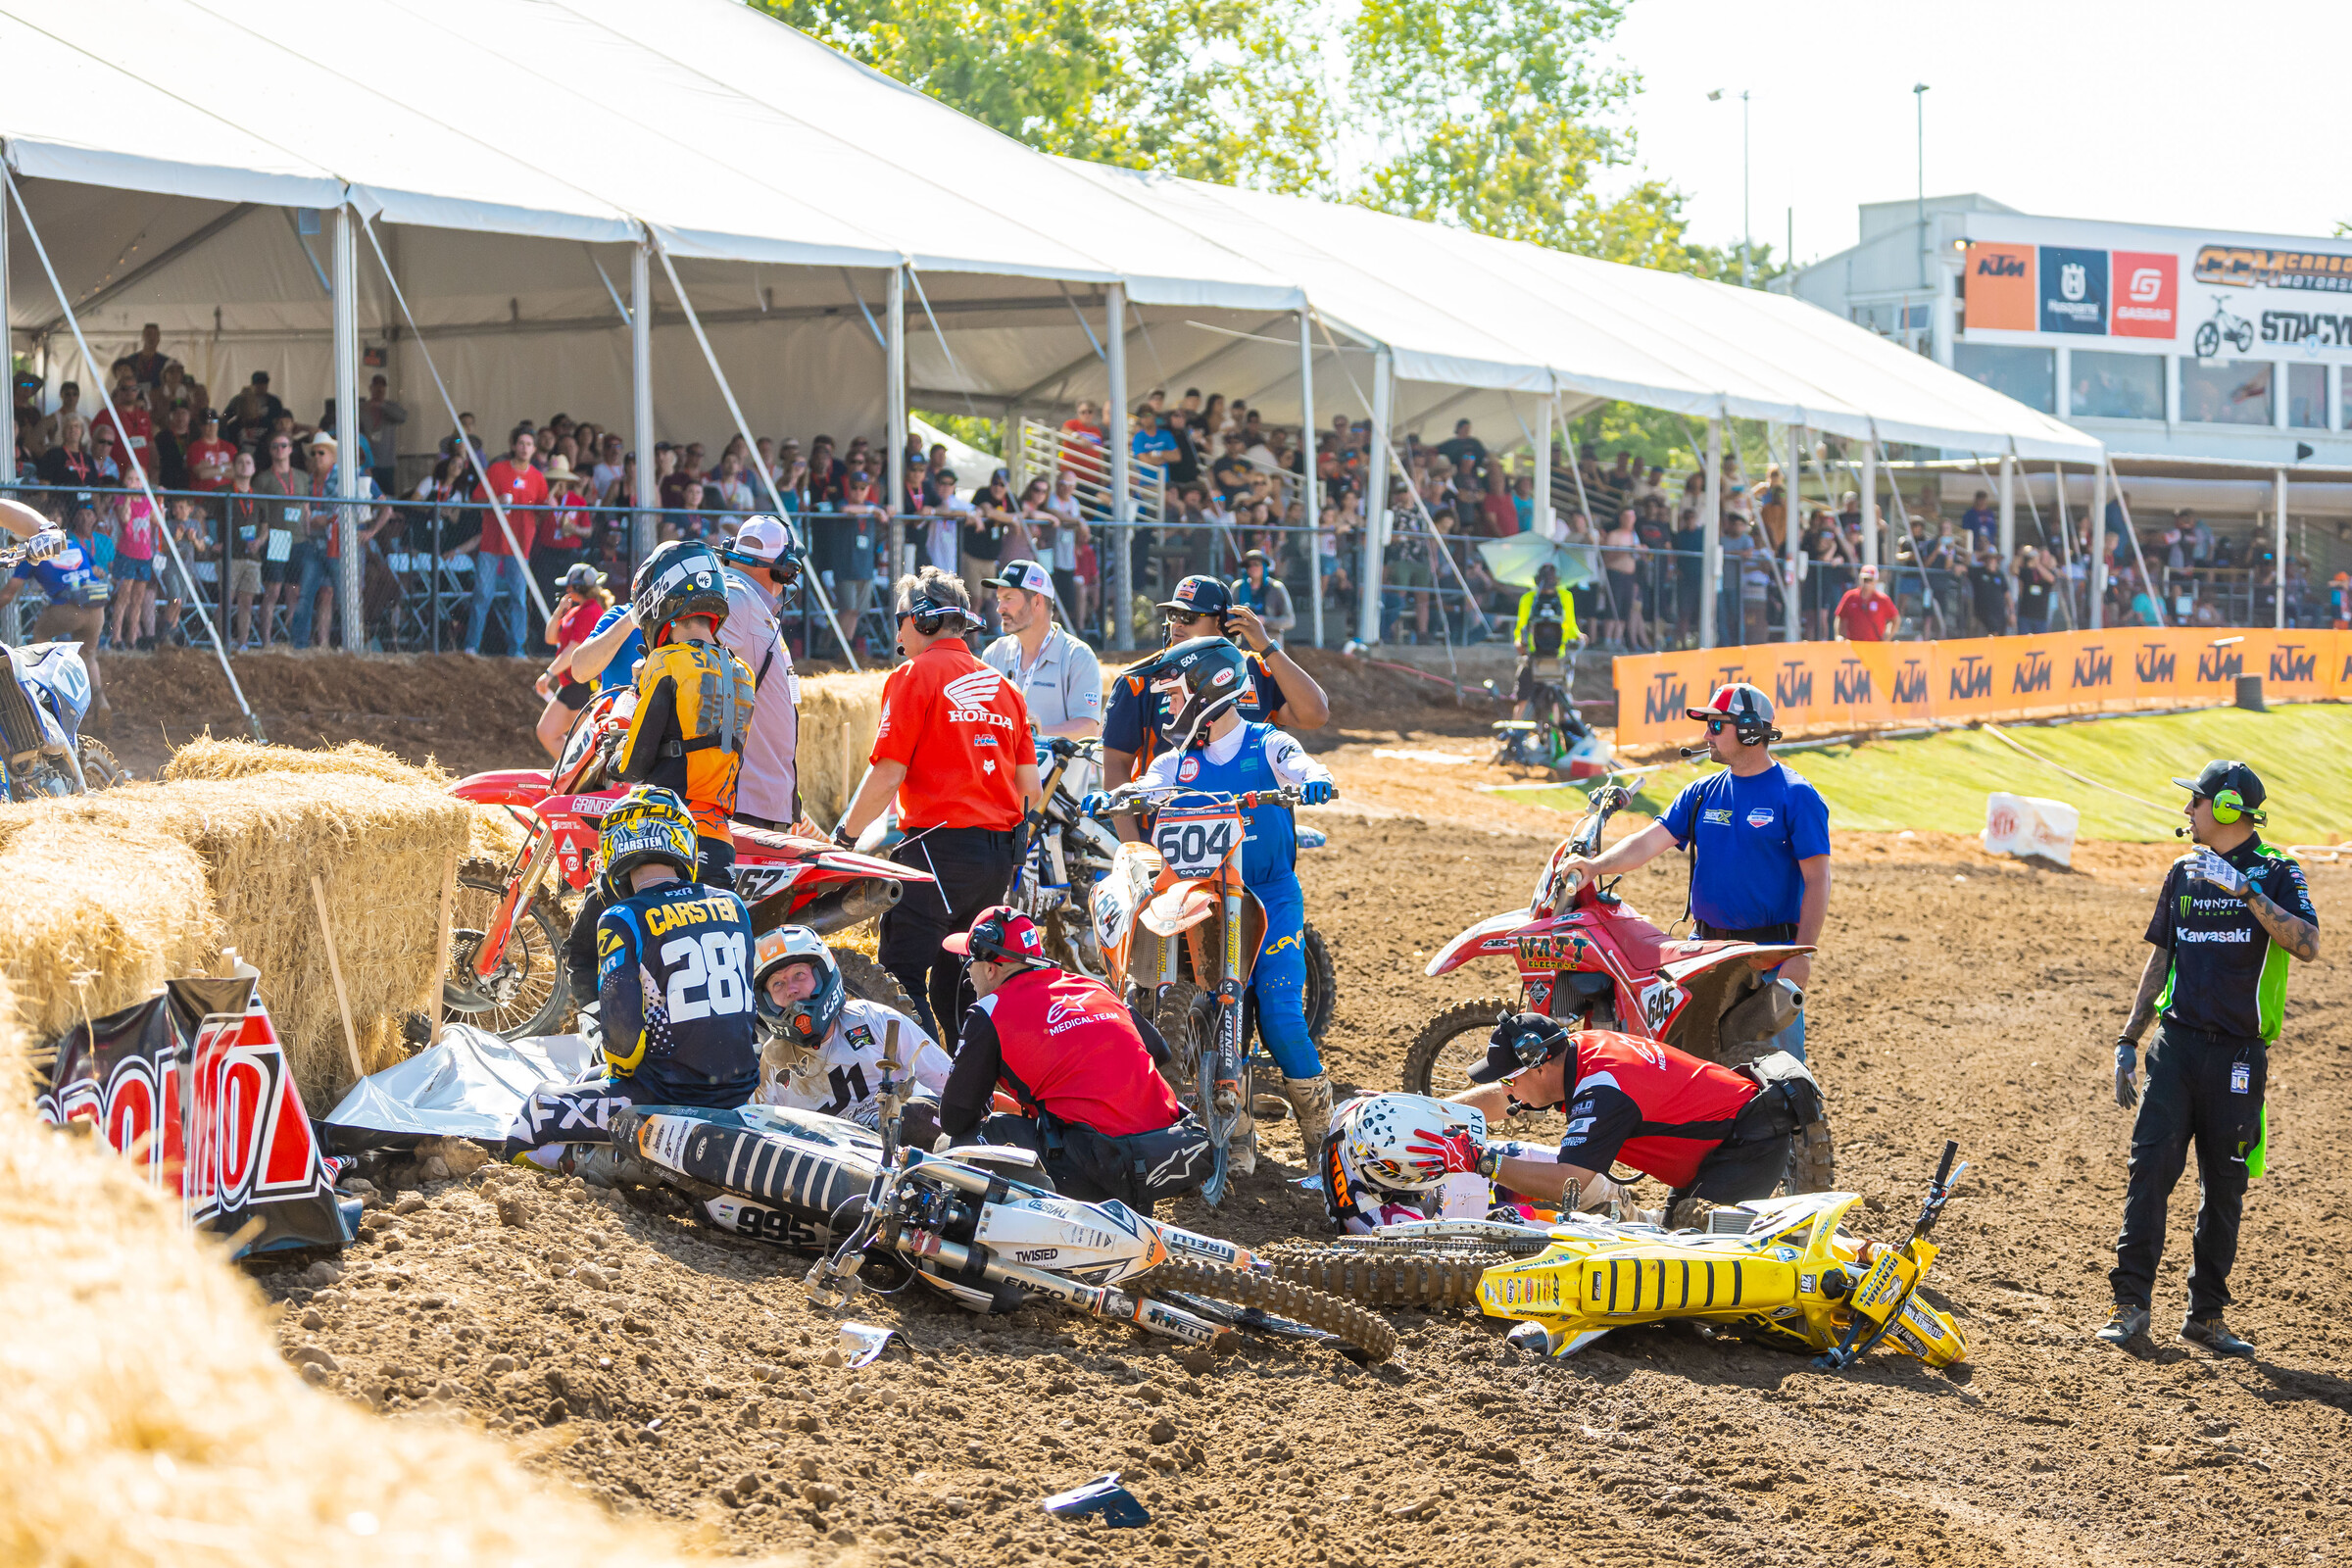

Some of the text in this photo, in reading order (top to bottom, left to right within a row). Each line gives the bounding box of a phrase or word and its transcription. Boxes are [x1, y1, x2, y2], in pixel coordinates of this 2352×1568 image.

[1978, 254, 2026, 277] KTM
[2195, 248, 2287, 287] CCM
[2117, 306, 2172, 321] GASGAS
[1181, 653, 1199, 668] 604
[1215, 671, 1233, 684] BELL
[1950, 657, 1992, 699] KTM
[2012, 652, 2052, 694] KTM
[2072, 646, 2114, 688] KTM
[2135, 644, 2176, 682] KTM
[2197, 644, 2244, 682] KTM
[2269, 645, 2317, 682] KTM
[59, 660, 86, 699] 78
[1776, 662, 1813, 709] KTM
[1834, 659, 1872, 705] KTM
[1892, 660, 1929, 704] KTM
[1644, 672, 1688, 724] KTM
[948, 710, 1014, 730] HONDA
[617, 836, 663, 854] CARSTEN
[1157, 822, 1233, 865] 604
[664, 886, 694, 898] FXR
[735, 868, 784, 902] 62
[645, 898, 740, 937] CARSTEN
[1096, 893, 1124, 939] 604
[2193, 897, 2248, 910] MONSTE
[1517, 935, 1590, 962] WATT
[2177, 927, 2252, 943] Kawasaki
[661, 931, 755, 1024] 281
[1049, 1012, 1120, 1037] MEDICAL TEAM
[1647, 986, 1676, 1029] 645
[1470, 1112, 1484, 1147] FOX
[736, 1205, 817, 1244] 995
[1028, 1200, 1070, 1219] TWISTED
[1015, 1248, 1058, 1262] TWISTED
[1171, 1233, 1236, 1264] PIRELLI
[1513, 1258, 1555, 1273] DUNLOP
[1003, 1276, 1066, 1300] ENZO
[1801, 1275, 1812, 1293] 281
[1859, 1253, 1891, 1304] RENTHAL
[1863, 1257, 1899, 1308] RENTHAL
[1149, 1307, 1214, 1343] PIRELLI
[1512, 1309, 1557, 1318] DUNLOP
